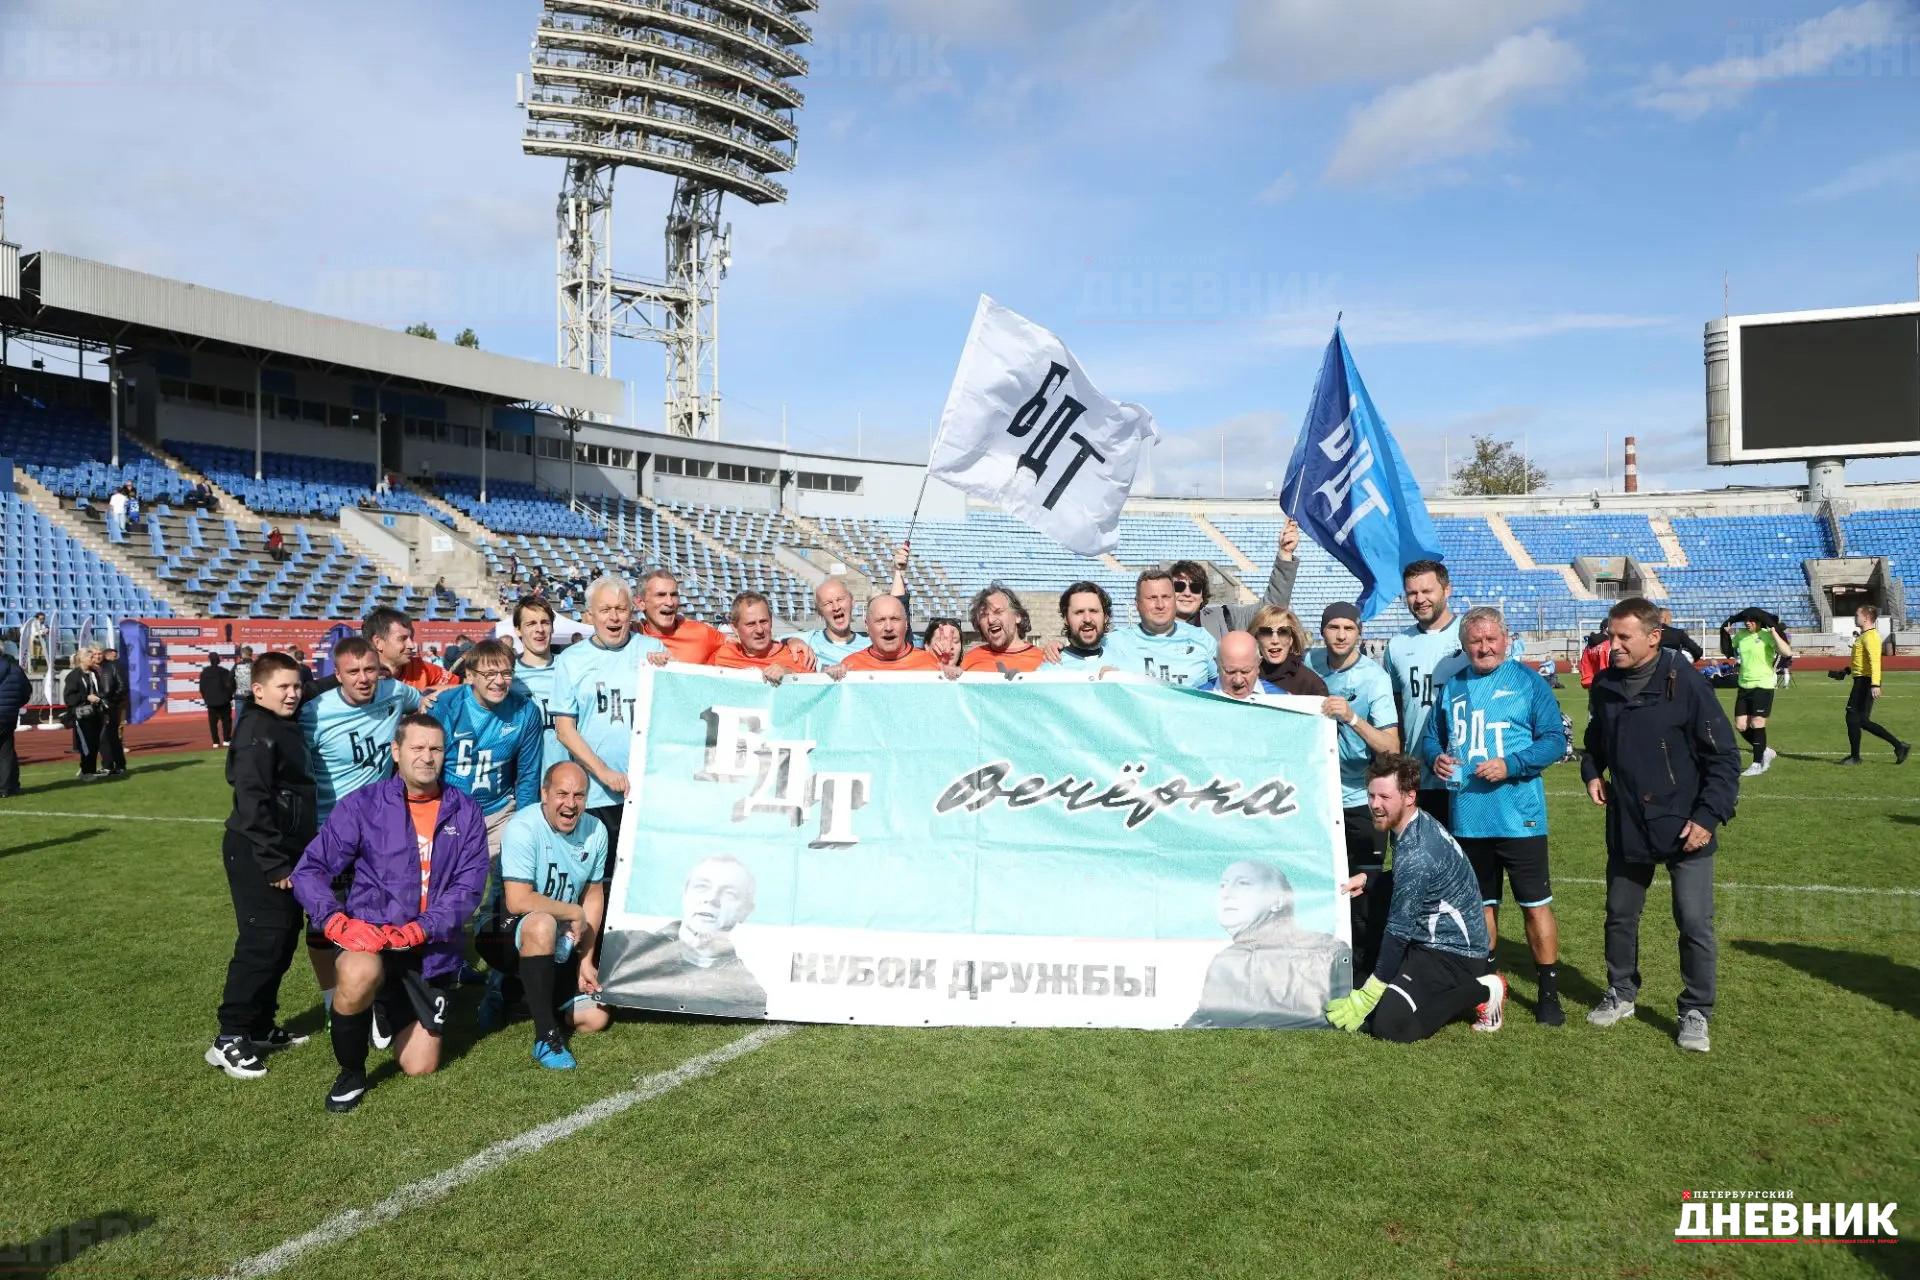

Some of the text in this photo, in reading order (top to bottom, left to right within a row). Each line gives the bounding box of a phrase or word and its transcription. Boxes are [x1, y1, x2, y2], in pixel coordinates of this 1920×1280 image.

[1006, 361, 1106, 511] БДТ
[1312, 393, 1390, 546] БДТ
[596, 681, 637, 731] БДТ
[1451, 700, 1511, 763] БДТ
[348, 731, 392, 774] БДТ
[693, 705, 1298, 850] БДТ Вечёрка
[789, 951, 1157, 1001] КУБОК ДРУЖБЫ
